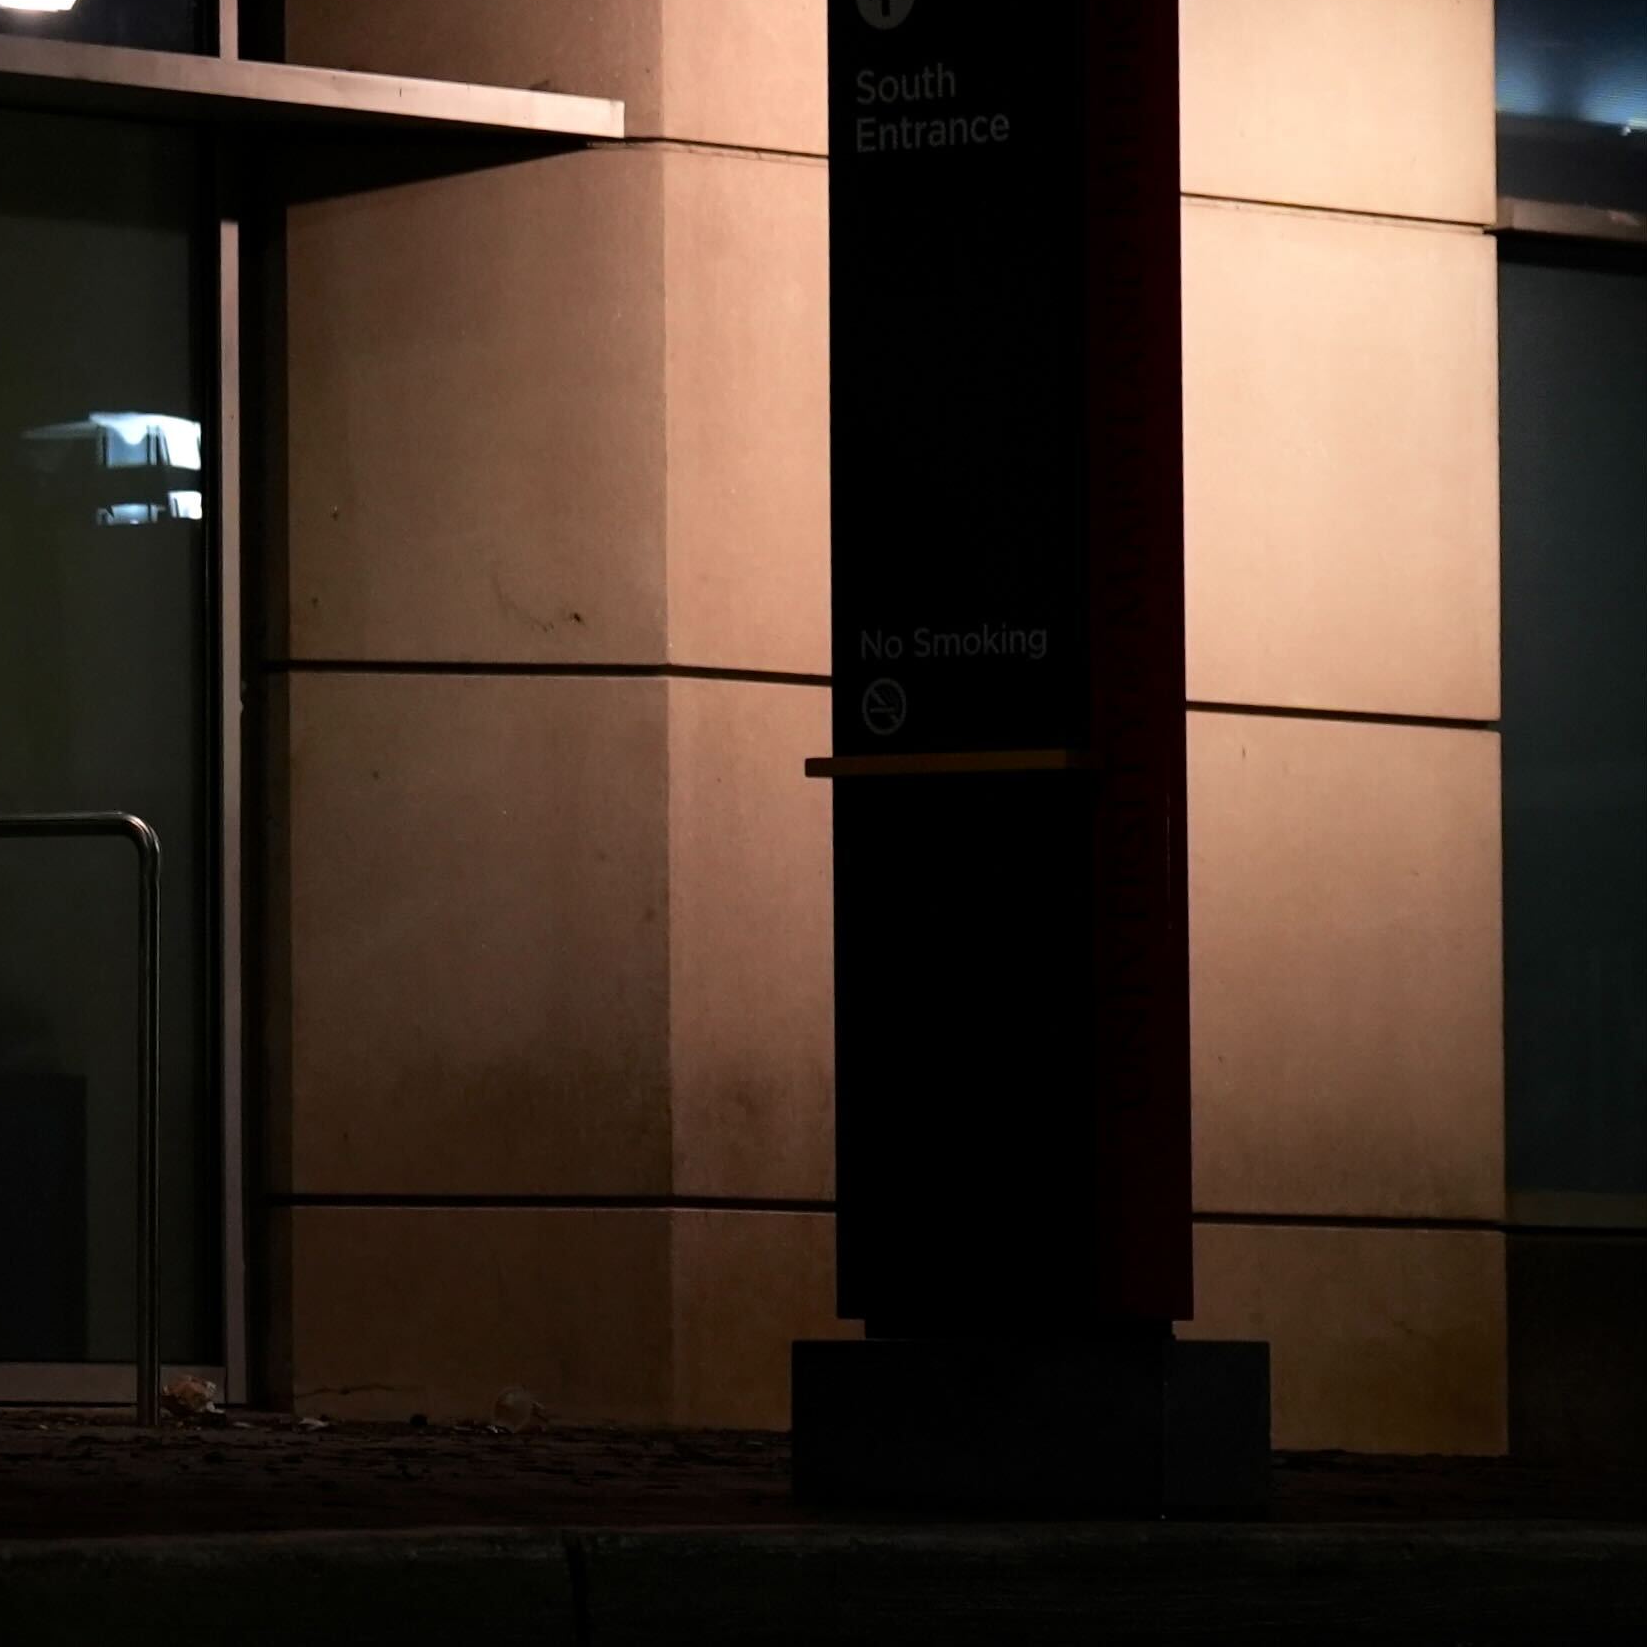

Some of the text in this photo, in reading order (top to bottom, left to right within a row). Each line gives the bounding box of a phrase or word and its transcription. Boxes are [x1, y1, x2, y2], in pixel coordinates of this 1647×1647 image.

[855, 62, 959, 106] South
[855, 111, 1011, 154] Entrance
[859, 621, 1049, 662] No Smoking
